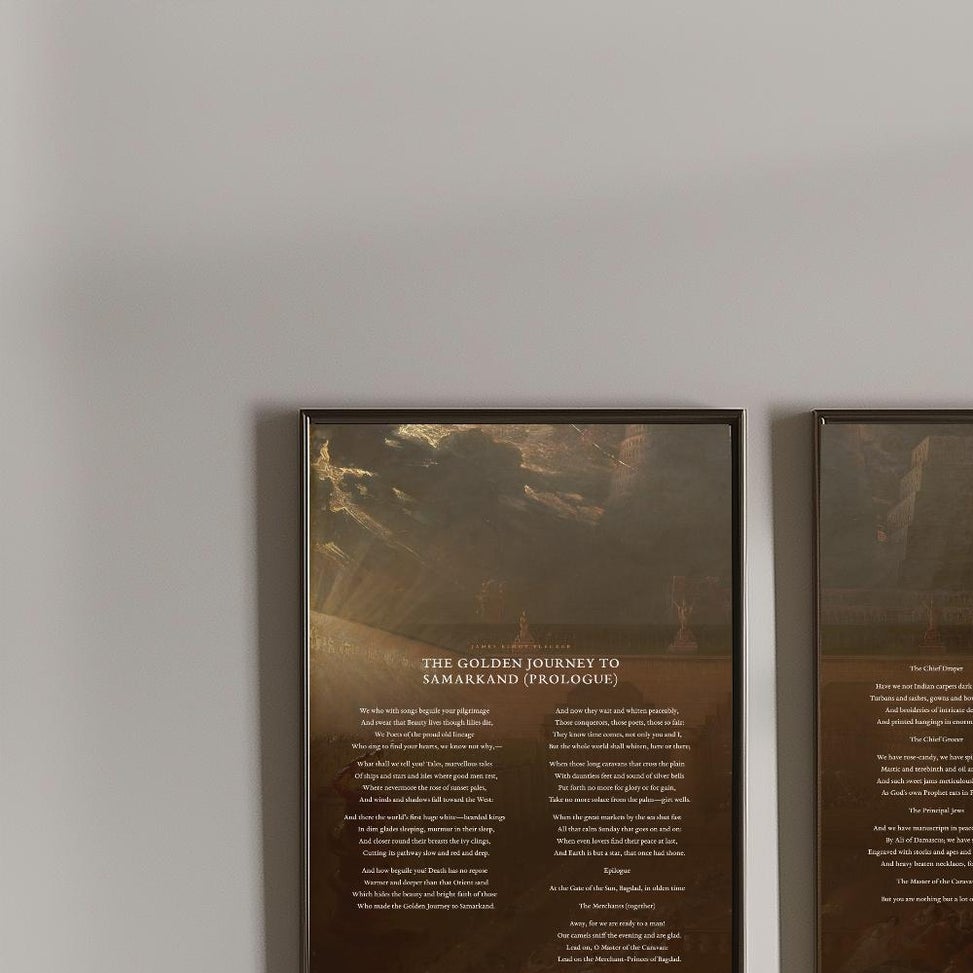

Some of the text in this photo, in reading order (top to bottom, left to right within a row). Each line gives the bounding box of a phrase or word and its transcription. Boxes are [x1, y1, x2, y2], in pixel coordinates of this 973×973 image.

[422, 658, 620, 671] THE GOLDEN JOURNEY TO
[422, 673, 619, 688] SAMARKAND (PROLOGUE)
[401, 708, 417, 716] songs
[442, 708, 455, 716] your
[457, 706, 490, 716] pilgrimage
[407, 718, 427, 728] Beauty
[443, 718, 465, 728] though
[625, 783, 640, 793] glory
[924, 789, 947, 798] Prophet
[619, 932, 642, 941] evening
